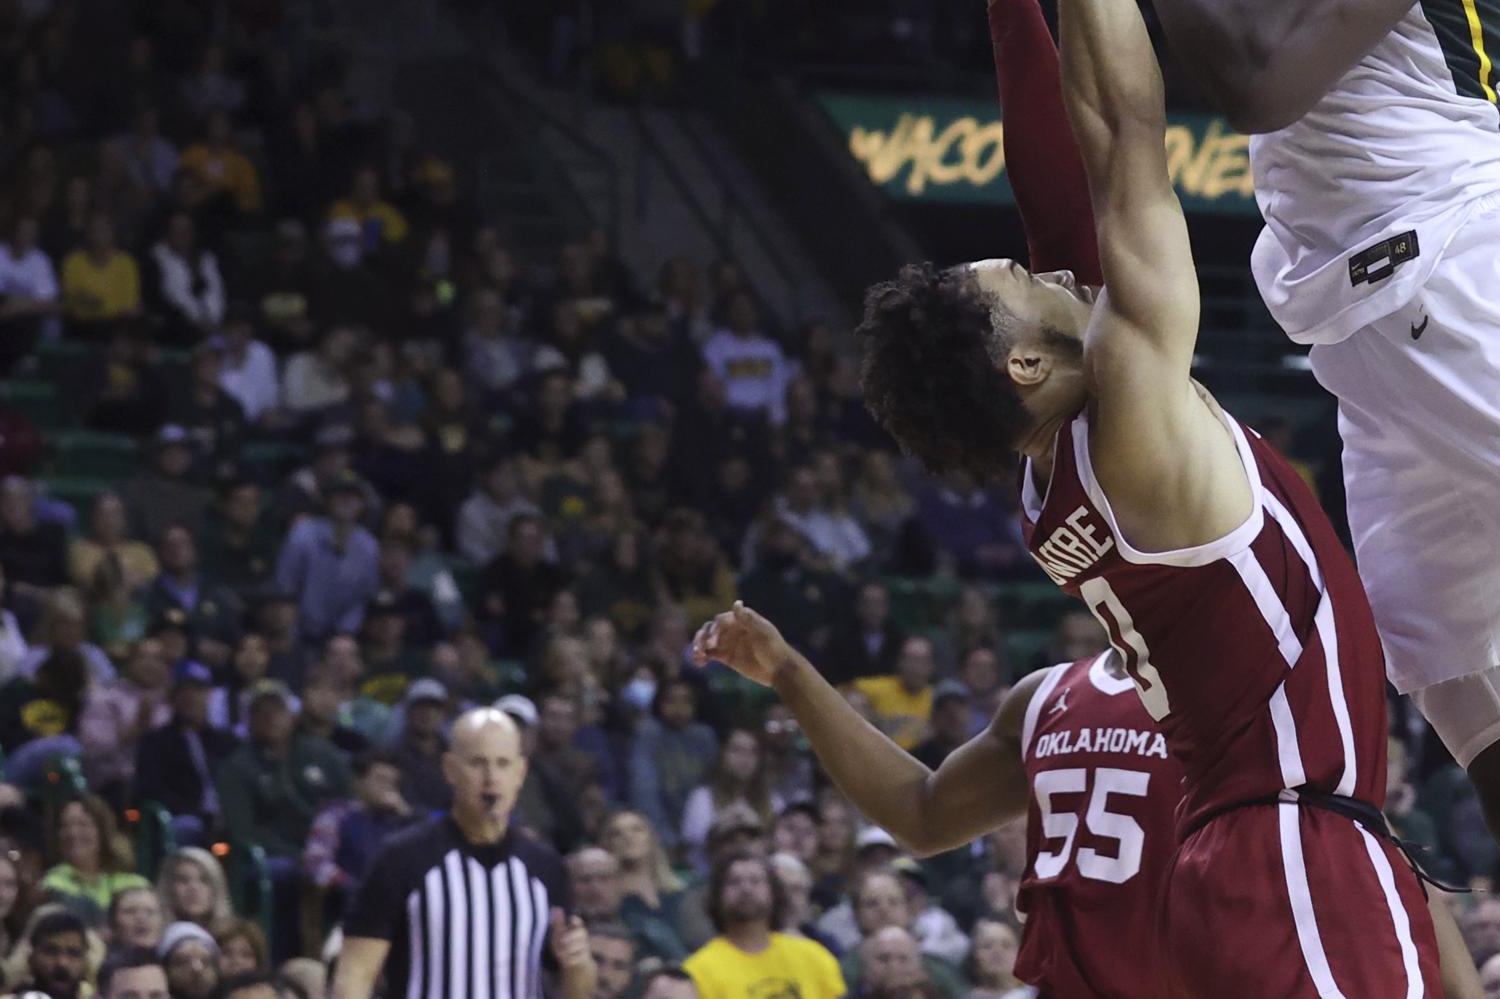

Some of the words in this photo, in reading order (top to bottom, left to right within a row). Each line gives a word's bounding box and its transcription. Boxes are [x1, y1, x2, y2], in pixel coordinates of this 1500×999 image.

[848, 113, 1007, 196] WACO
[1079, 575, 1171, 722] 0
[1035, 727, 1169, 760] OKLAHOMA
[1033, 767, 1151, 885] 55
